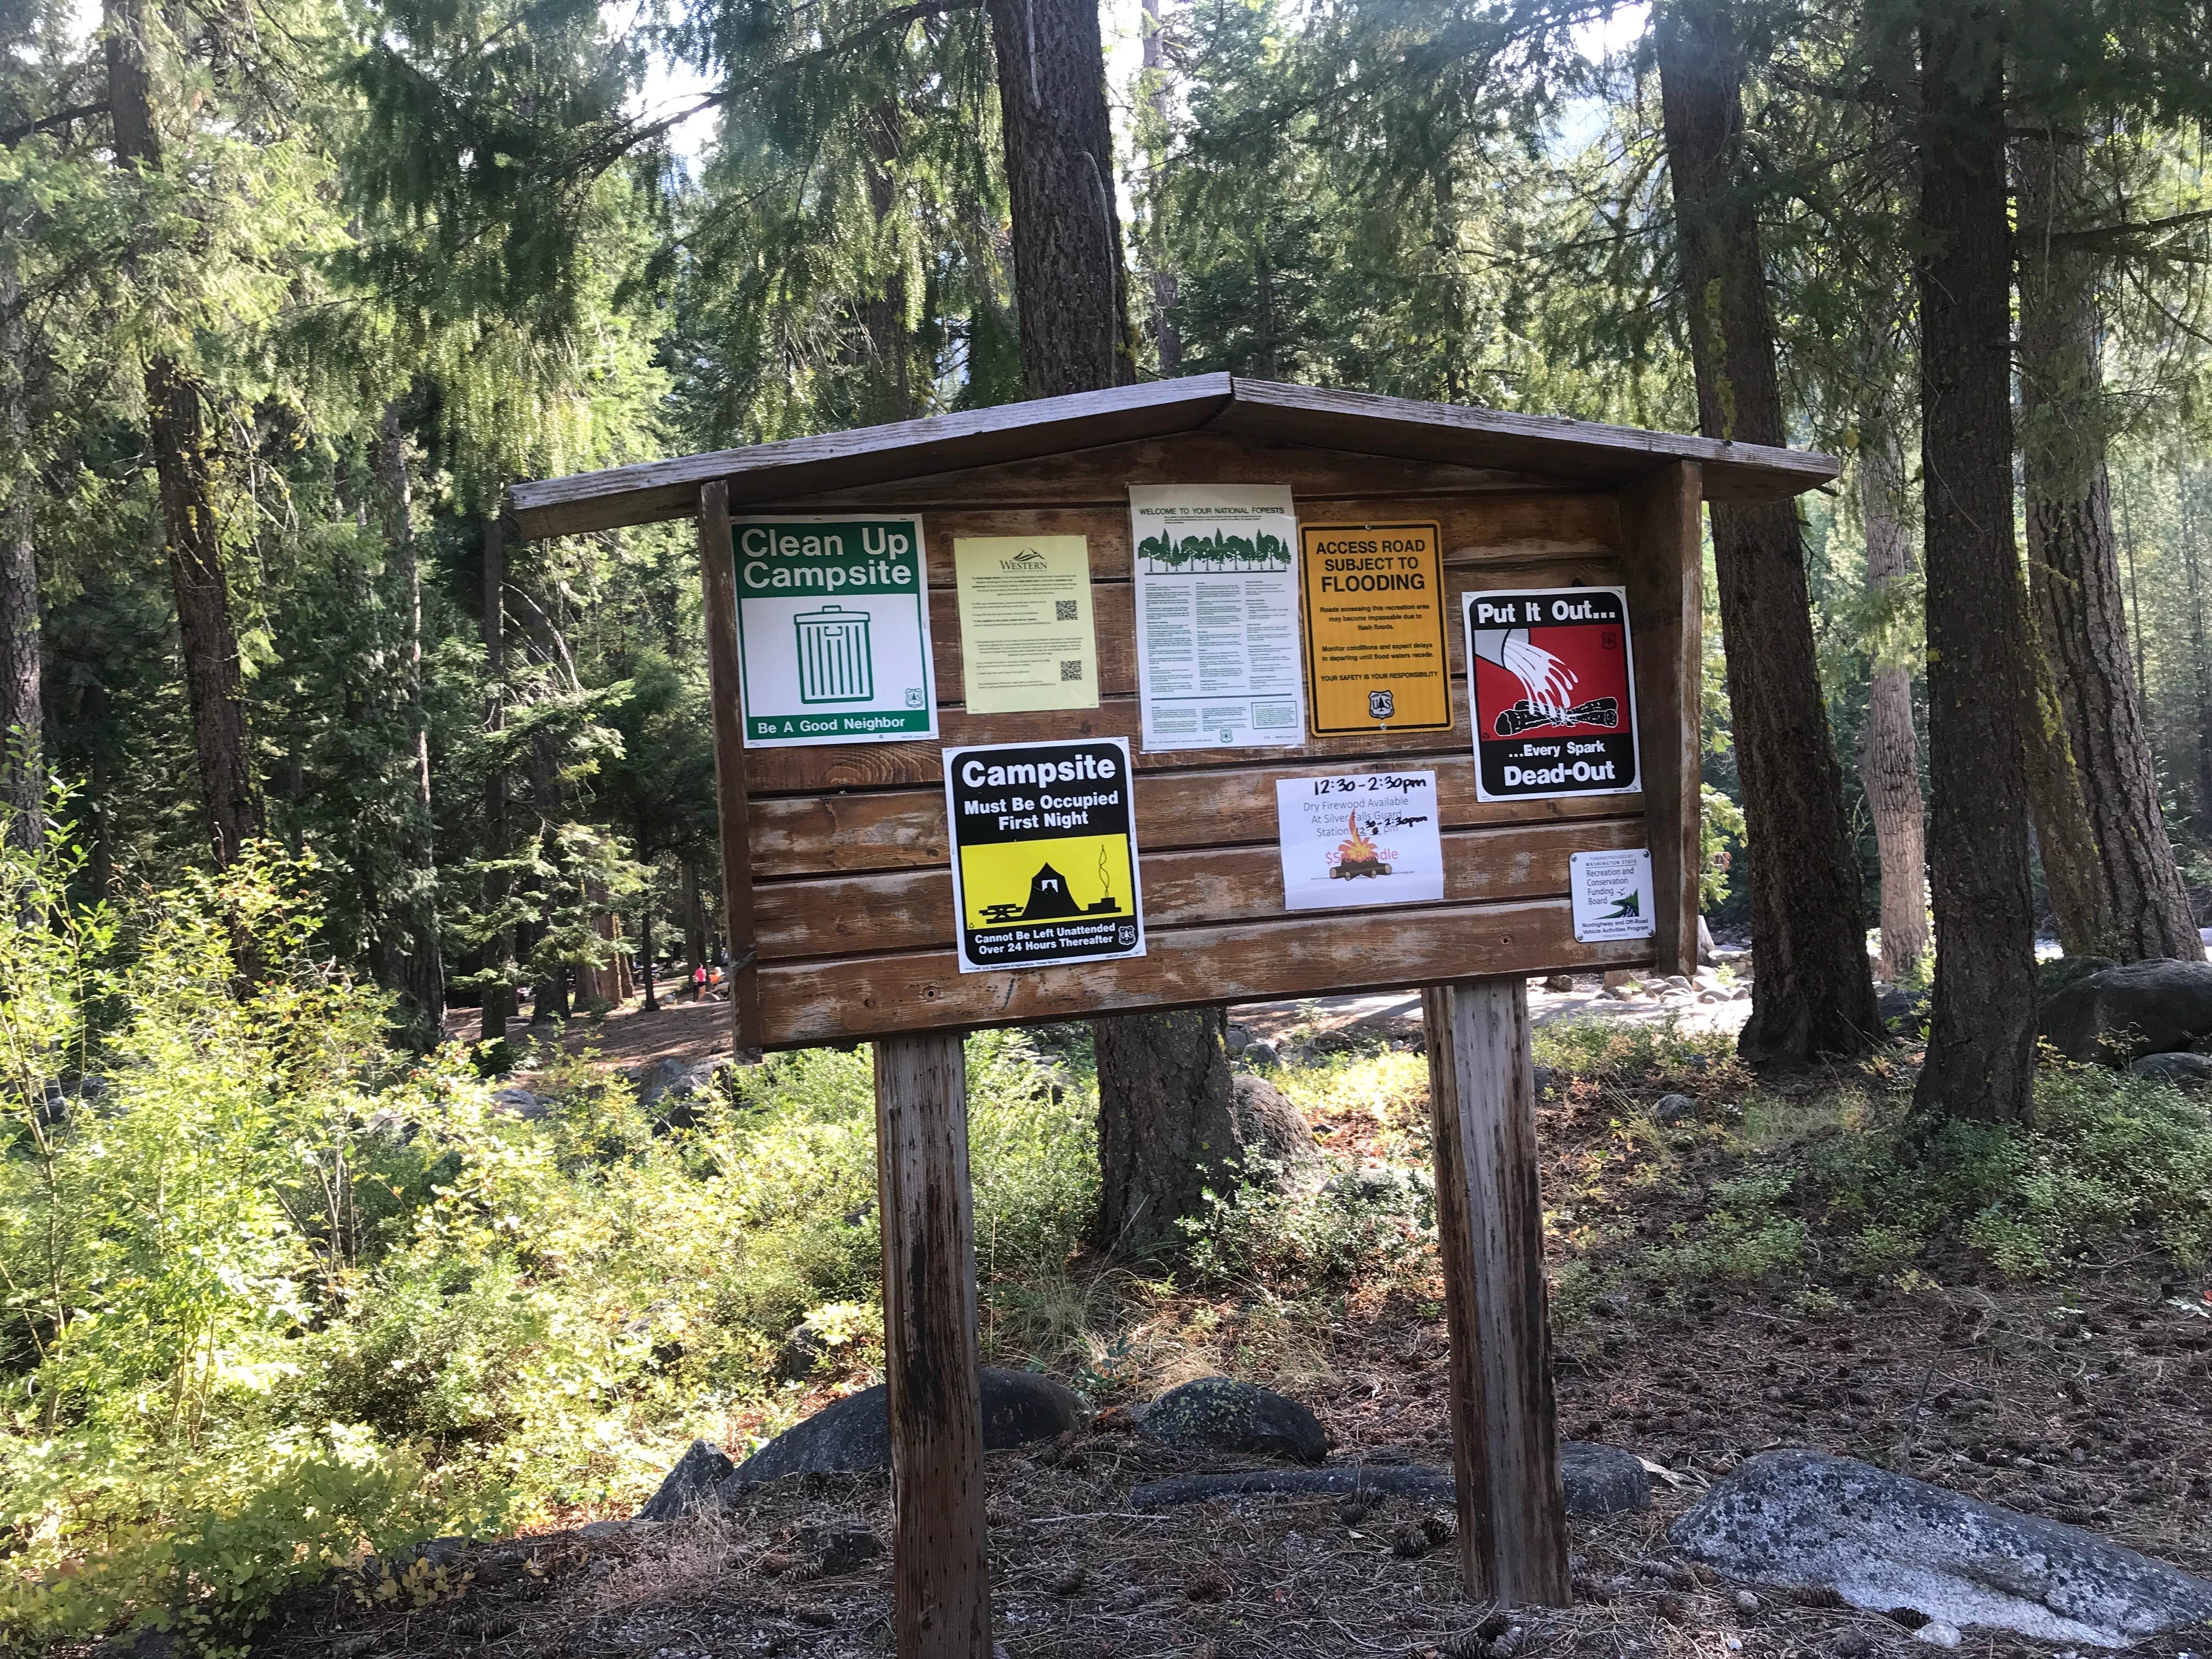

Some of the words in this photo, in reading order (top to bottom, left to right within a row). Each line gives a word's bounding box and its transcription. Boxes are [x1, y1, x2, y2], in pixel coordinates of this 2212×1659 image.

[741, 528, 843, 557] Clean
[862, 527, 909, 560] Up
[1316, 541, 1378, 555] ACCESS
[1382, 539, 1425, 553] ROAD
[1325, 557, 1394, 572] SUBJECT
[1398, 556, 1419, 569] TO
[743, 560, 912, 591] Campsite
[1321, 573, 1425, 592] FLOODING
[1477, 604, 1517, 624] Put
[1526, 602, 1542, 622] It
[1551, 600, 1616, 620] Out...
[757, 721, 777, 734] Be
[783, 720, 794, 733] A
[799, 719, 838, 732] Good
[844, 717, 906, 731] Neighbor
[1508, 743, 1561, 758] ...Every
[1566, 740, 1606, 756] Spark
[961, 754, 1116, 788] Campsite
[1504, 760, 1616, 786] Dead-Out
[964, 799, 1007, 815] Must
[1012, 797, 1035, 811] Be
[1040, 791, 1119, 809] Occupied
[1303, 802, 1320, 812] Dry
[1322, 799, 1365, 810] Firewood
[1367, 796, 1409, 808] Available
[998, 815, 1039, 831] First
[1044, 811, 1089, 829] Night
[1311, 815, 1322, 823] At
[1324, 813, 1349, 823] Silver
[1352, 811, 1372, 822] Falls
[1374, 809, 1402, 820] Guard
[1384, 824, 1399, 834] pm
[1325, 851, 1341, 865] $5
[1586, 868, 1621, 877] Recreation
[1622, 866, 1634, 874] and
[1587, 876, 1628, 886] Conservation
[1587, 887, 1614, 896] Funding
[1588, 896, 1607, 905] Board
[974, 932, 1013, 944] Cannot
[1015, 931, 1030, 940] Be
[1033, 929, 1054, 939] Left
[1057, 923, 1116, 936] Unattended
[979, 945, 1005, 955] Over
[1007, 943, 1022, 952] 24
[1025, 940, 1057, 951] Hours
[1059, 935, 1114, 947] Thereafter
